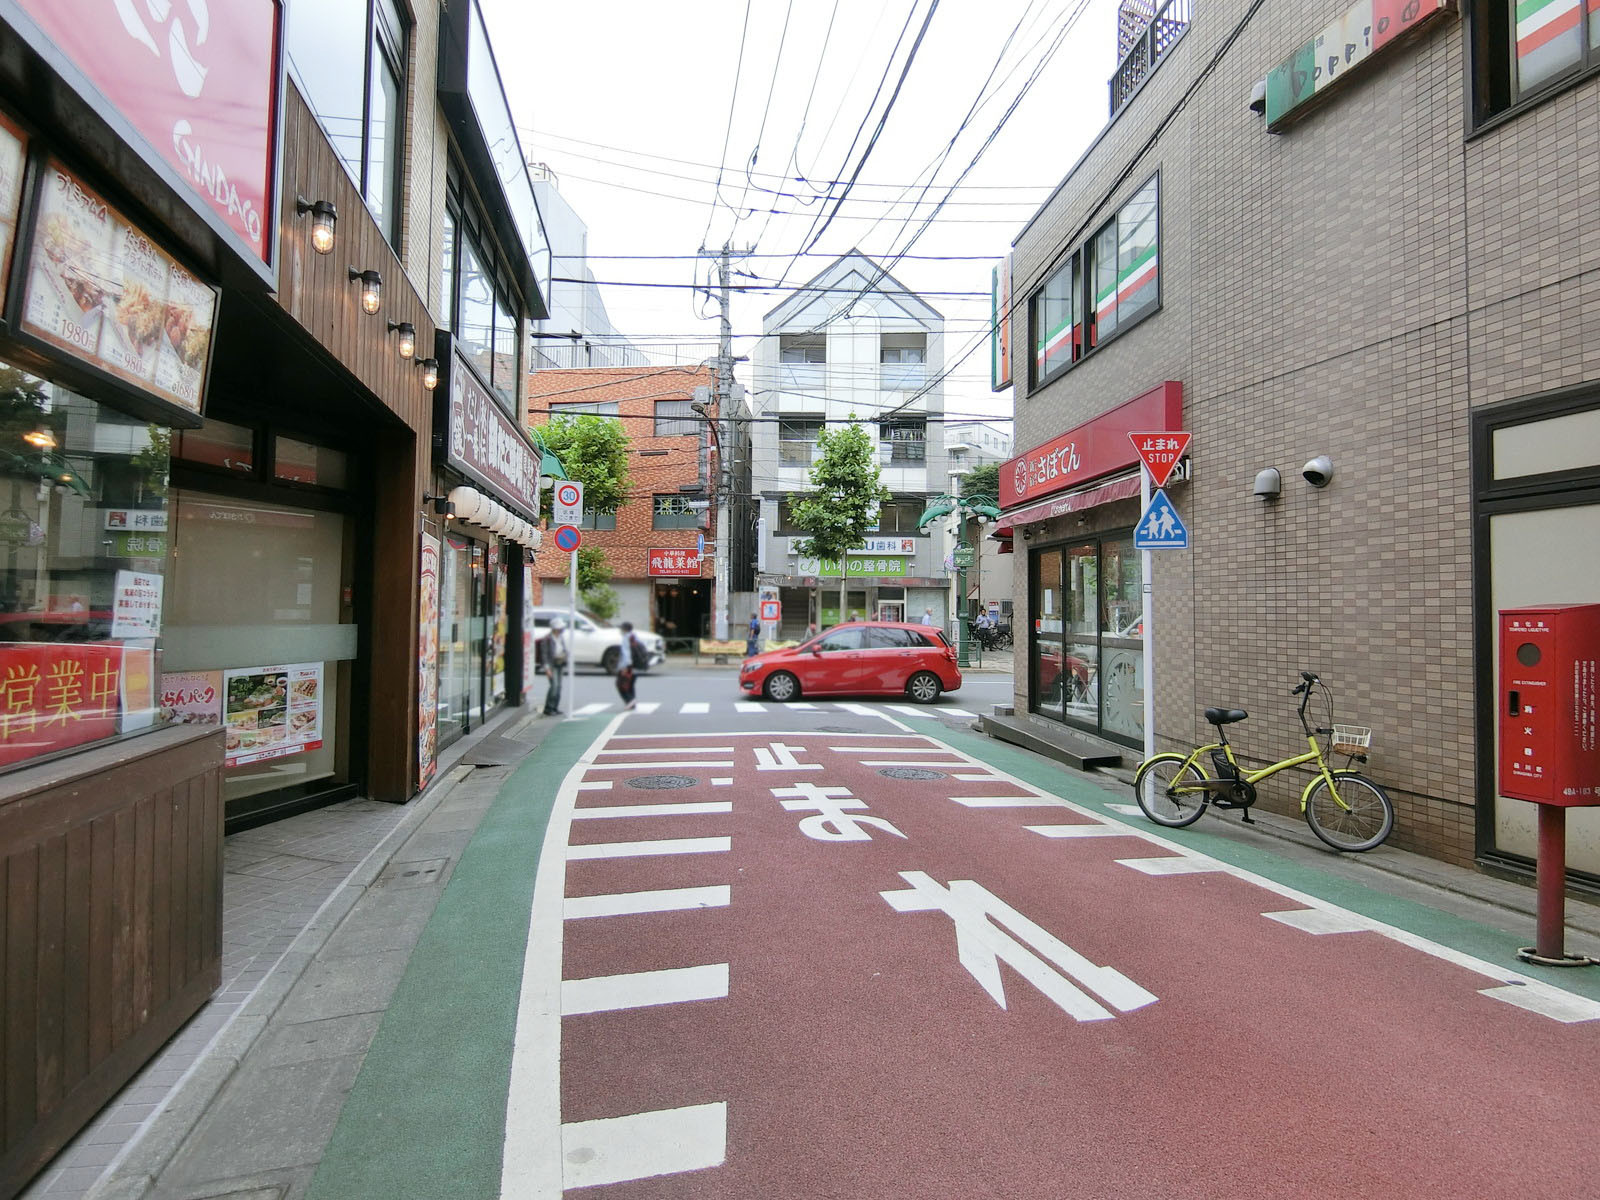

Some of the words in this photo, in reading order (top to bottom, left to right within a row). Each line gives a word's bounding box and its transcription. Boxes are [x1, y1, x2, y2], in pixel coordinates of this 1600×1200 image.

[1141, 437, 1180, 451] 止まれ
[1037, 442, 1081, 483] さぼてん
[1148, 453, 1175, 463] STOP
[563, 490, 576, 501] 30
[651, 556, 698, 569] 飛龍菜館
[0, 658, 120, 740] 営業中
[753, 742, 1159, 1022] 止まれ
